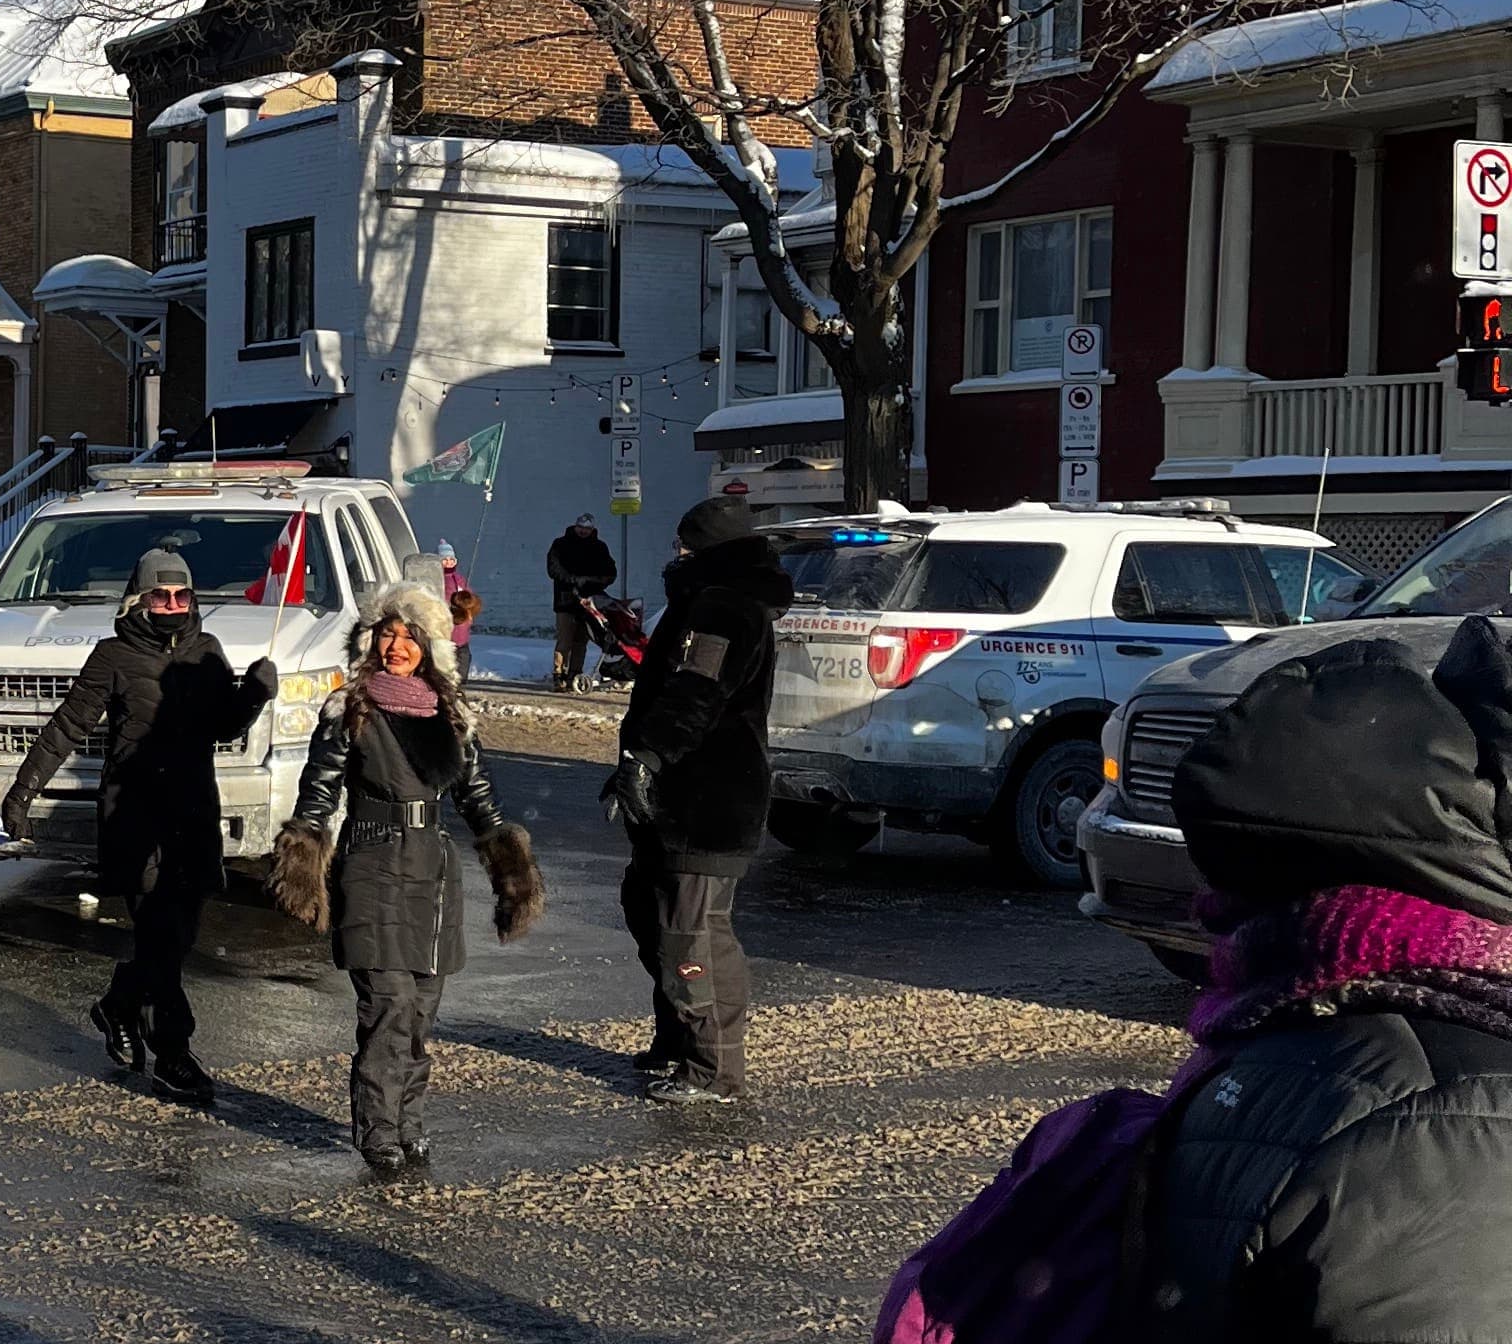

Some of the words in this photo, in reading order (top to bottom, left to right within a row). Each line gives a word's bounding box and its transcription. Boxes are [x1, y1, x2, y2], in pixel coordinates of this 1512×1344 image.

[620, 376, 633, 395] P
[621, 441, 633, 457] P
[1071, 463, 1087, 486] P
[776, 618, 837, 630] URGENCE
[842, 621, 866, 631] 911
[980, 640, 1056, 654] URGENCE
[1060, 643, 1084, 655] 911
[812, 656, 862, 679] 7218
